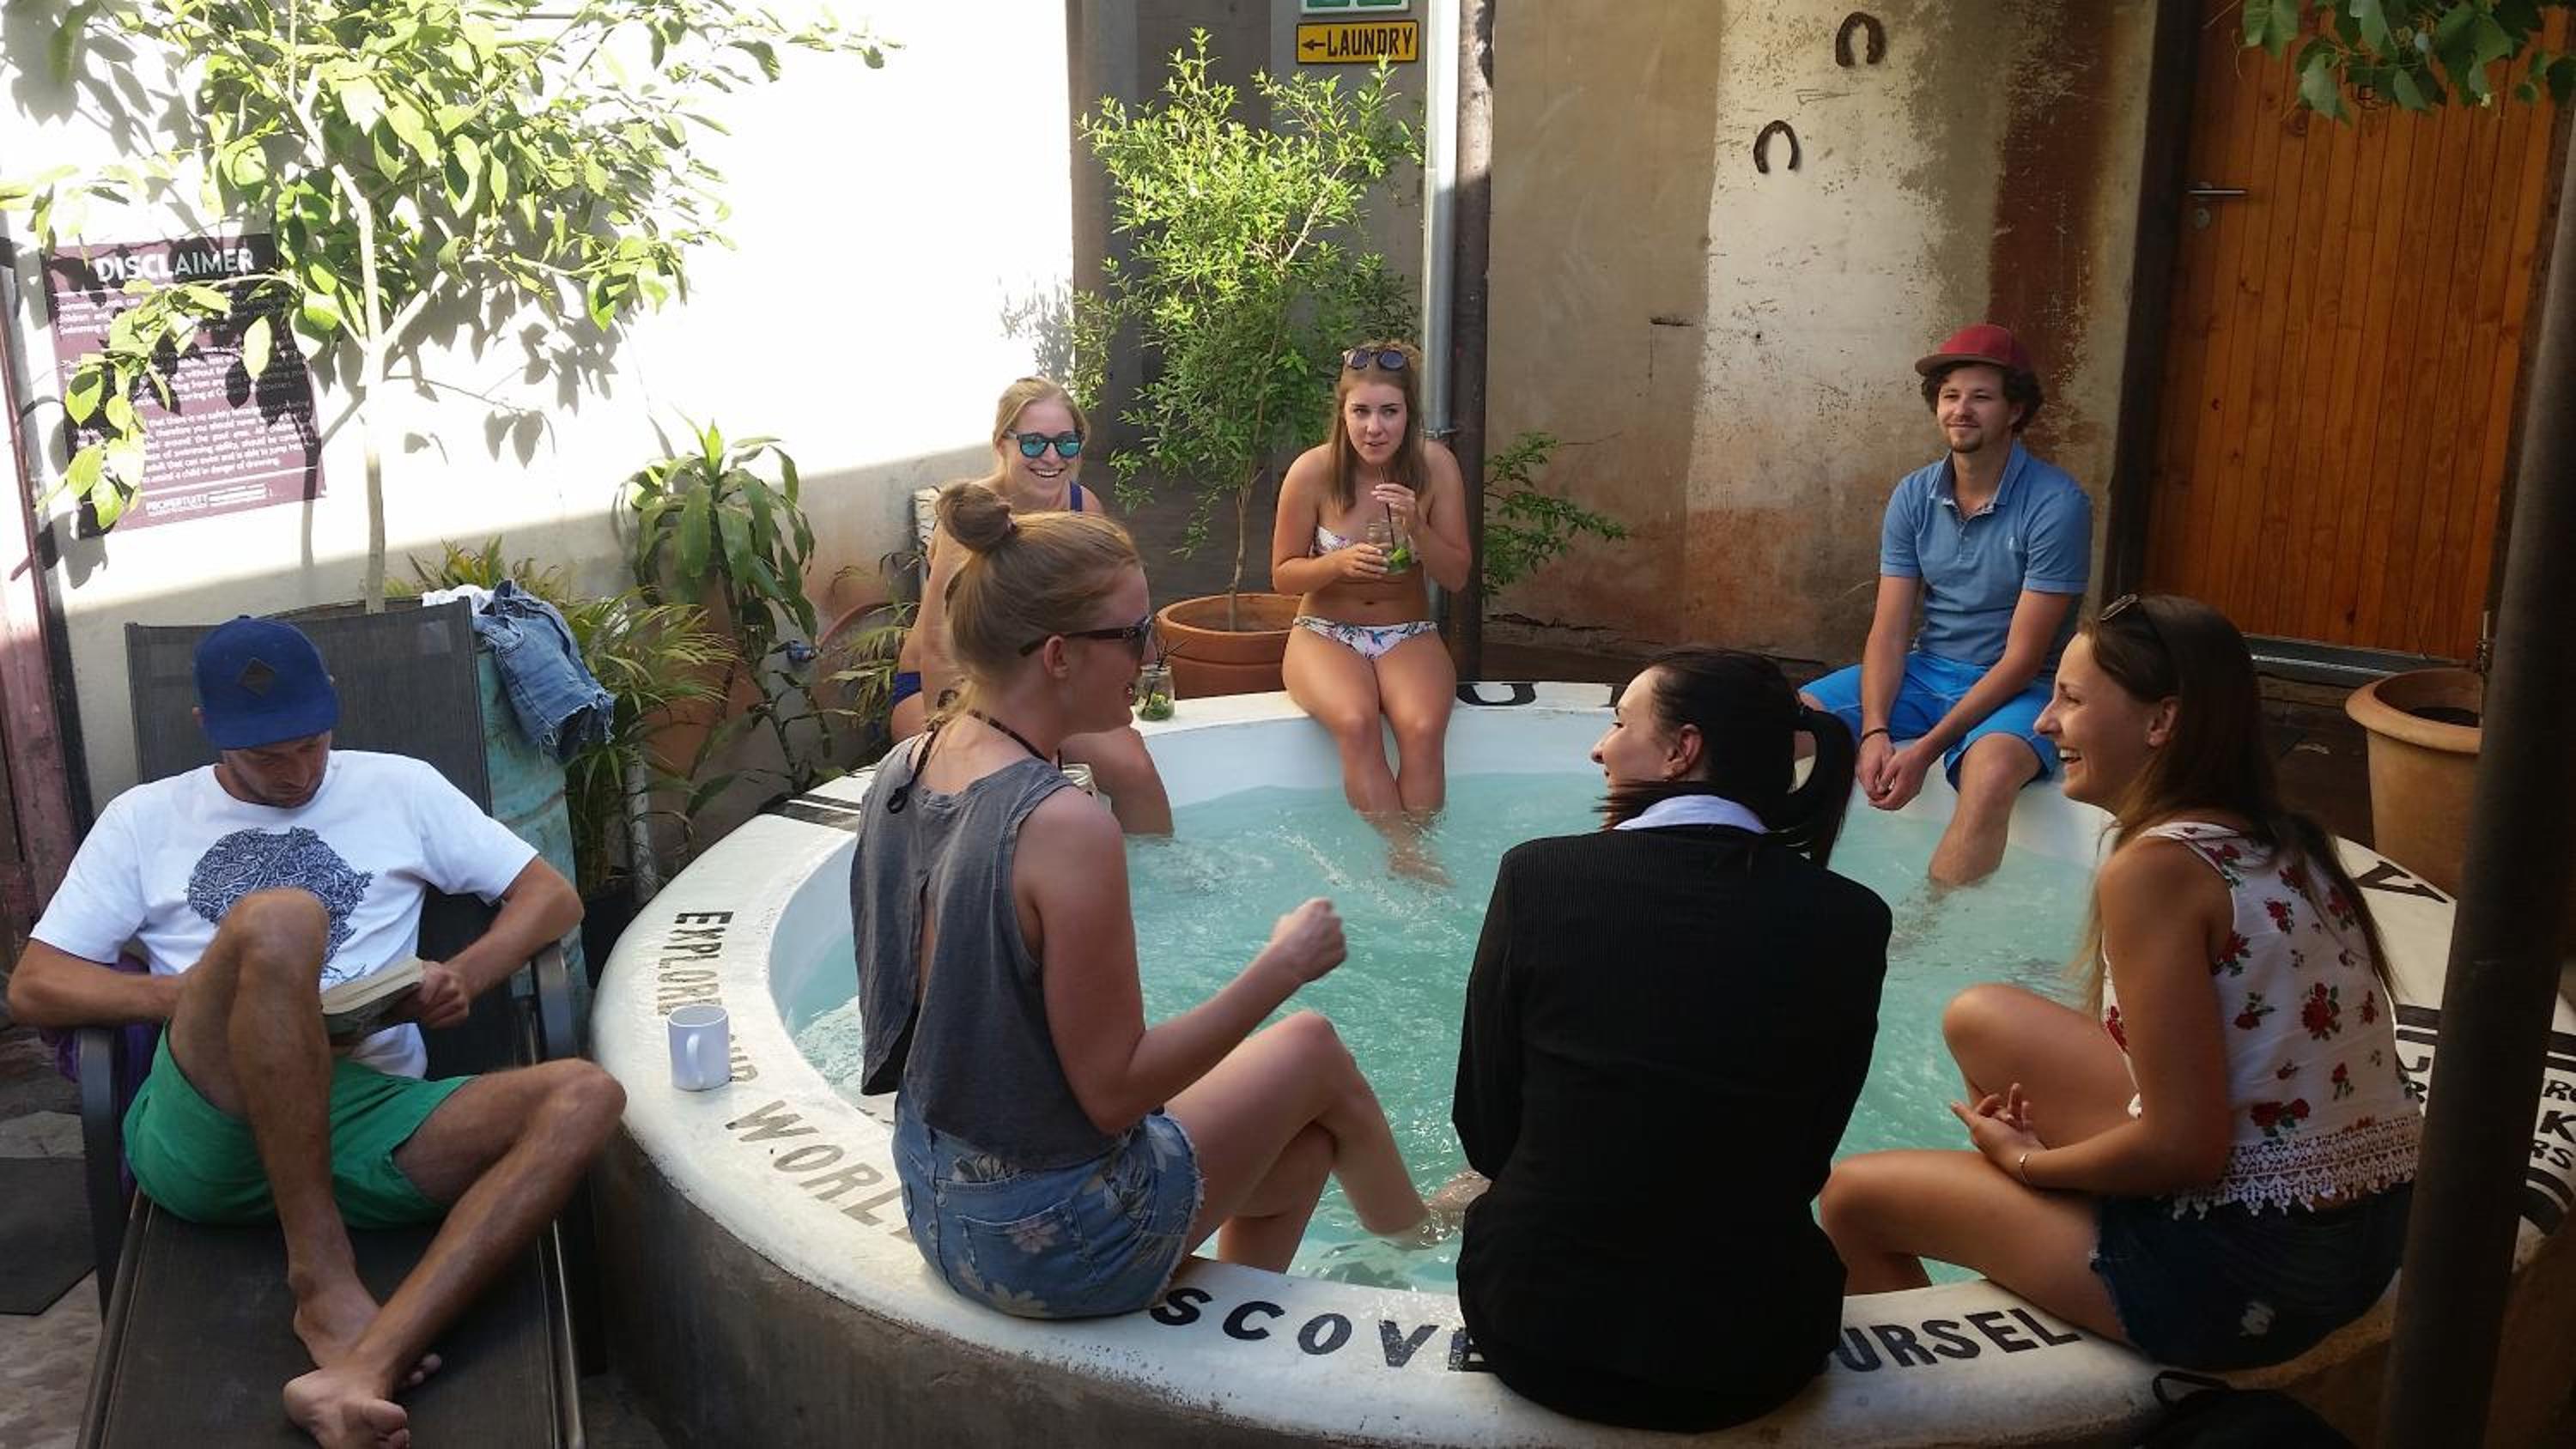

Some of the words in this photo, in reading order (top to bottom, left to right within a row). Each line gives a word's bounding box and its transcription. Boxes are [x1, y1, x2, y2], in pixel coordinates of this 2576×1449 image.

[1327, 27, 1413, 57] LAUNDRY
[95, 249, 255, 282] DISCLAIMER
[725, 1100, 914, 1243] WORL
[1834, 1308, 2082, 1373] URSEL
